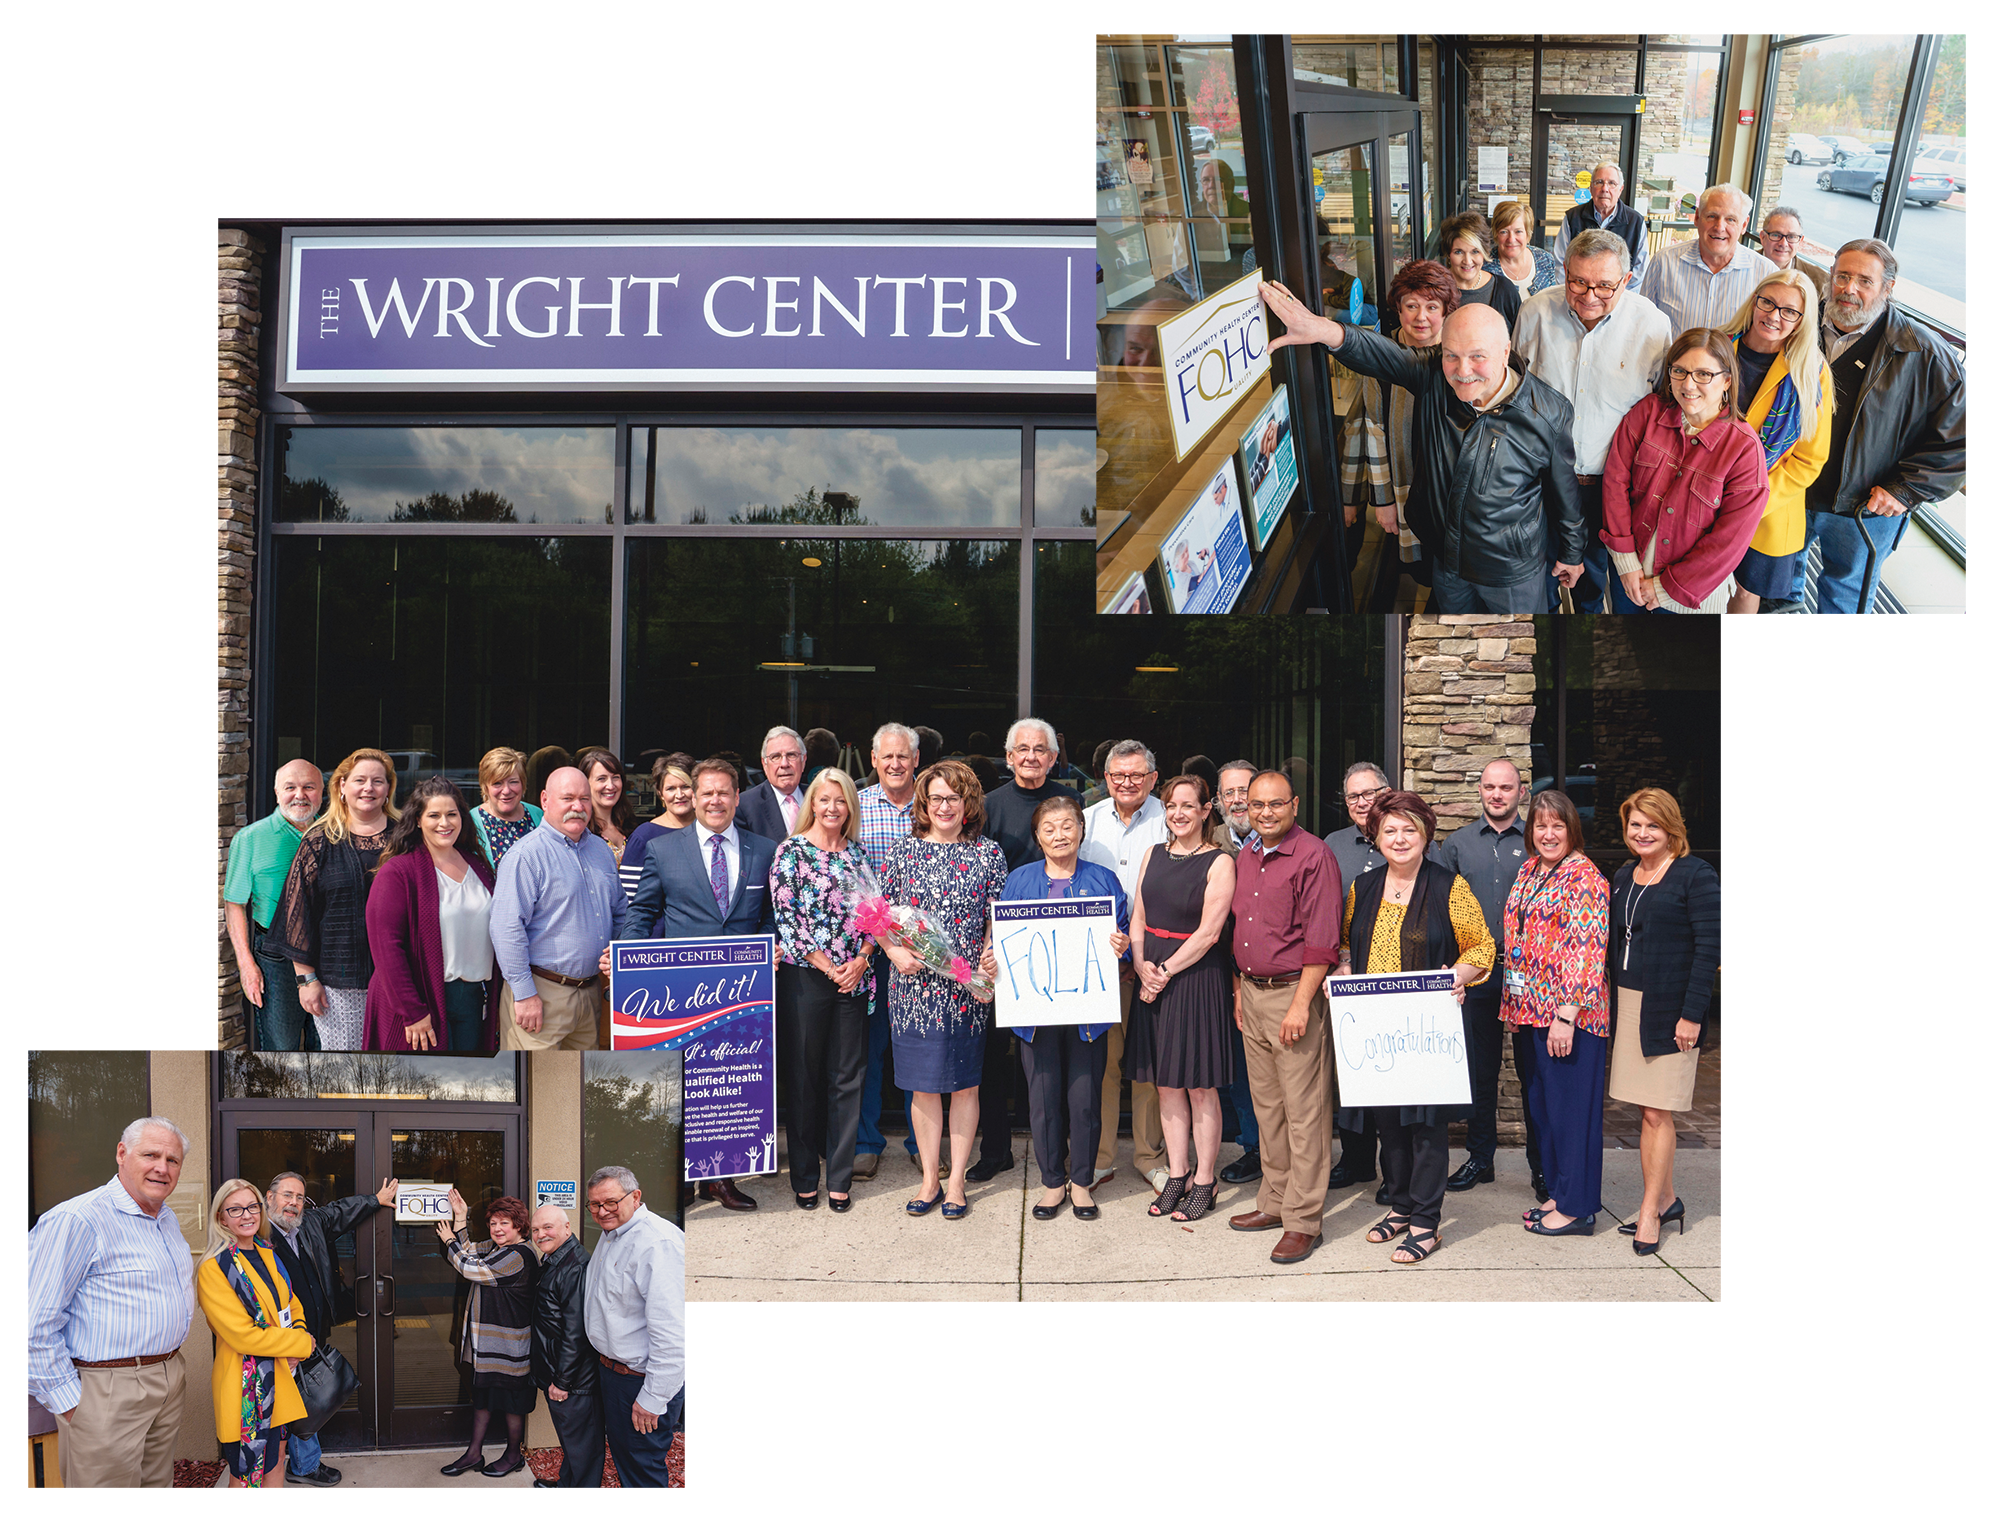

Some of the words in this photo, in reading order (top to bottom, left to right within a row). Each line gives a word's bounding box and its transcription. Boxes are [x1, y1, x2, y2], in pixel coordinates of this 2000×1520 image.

[320, 286, 340, 339] THE
[349, 272, 681, 348] WRIGHT
[702, 274, 1041, 346] CENTER
[1175, 332, 1218, 368] COMMUNITY
[1219, 316, 1242, 336] HEALTH
[1241, 302, 1260, 320] CENTER
[1177, 315, 1264, 424] FQHC
[1000, 907, 1039, 918] WRIGHT
[1041, 905, 1080, 915] CENTER
[627, 952, 676, 965] WRIGHT
[679, 950, 727, 962] CENTER
[734, 953, 762, 961] HEALTH
[1001, 926, 1106, 1002] FQLA
[1336, 982, 1377, 994] WRIGHT
[1380, 980, 1421, 990] CENTER
[1427, 982, 1452, 990] HEALTH
[621, 985, 680, 1023] We
[684, 978, 727, 1009] did
[728, 969, 758, 1002] it!
[710, 1038, 763, 1061] official!
[692, 1065, 729, 1074] Community
[730, 1063, 751, 1072] Health
[685, 1074, 725, 1087] ualified
[728, 1072, 762, 1084] Health
[685, 1088, 710, 1099] Look
[712, 1085, 742, 1097] Alike!
[716, 1117, 743, 1125] responsive
[708, 1133, 733, 1142] privileged
[539, 1183, 574, 1191] NOTICE
[400, 1198, 449, 1216] FQHC
